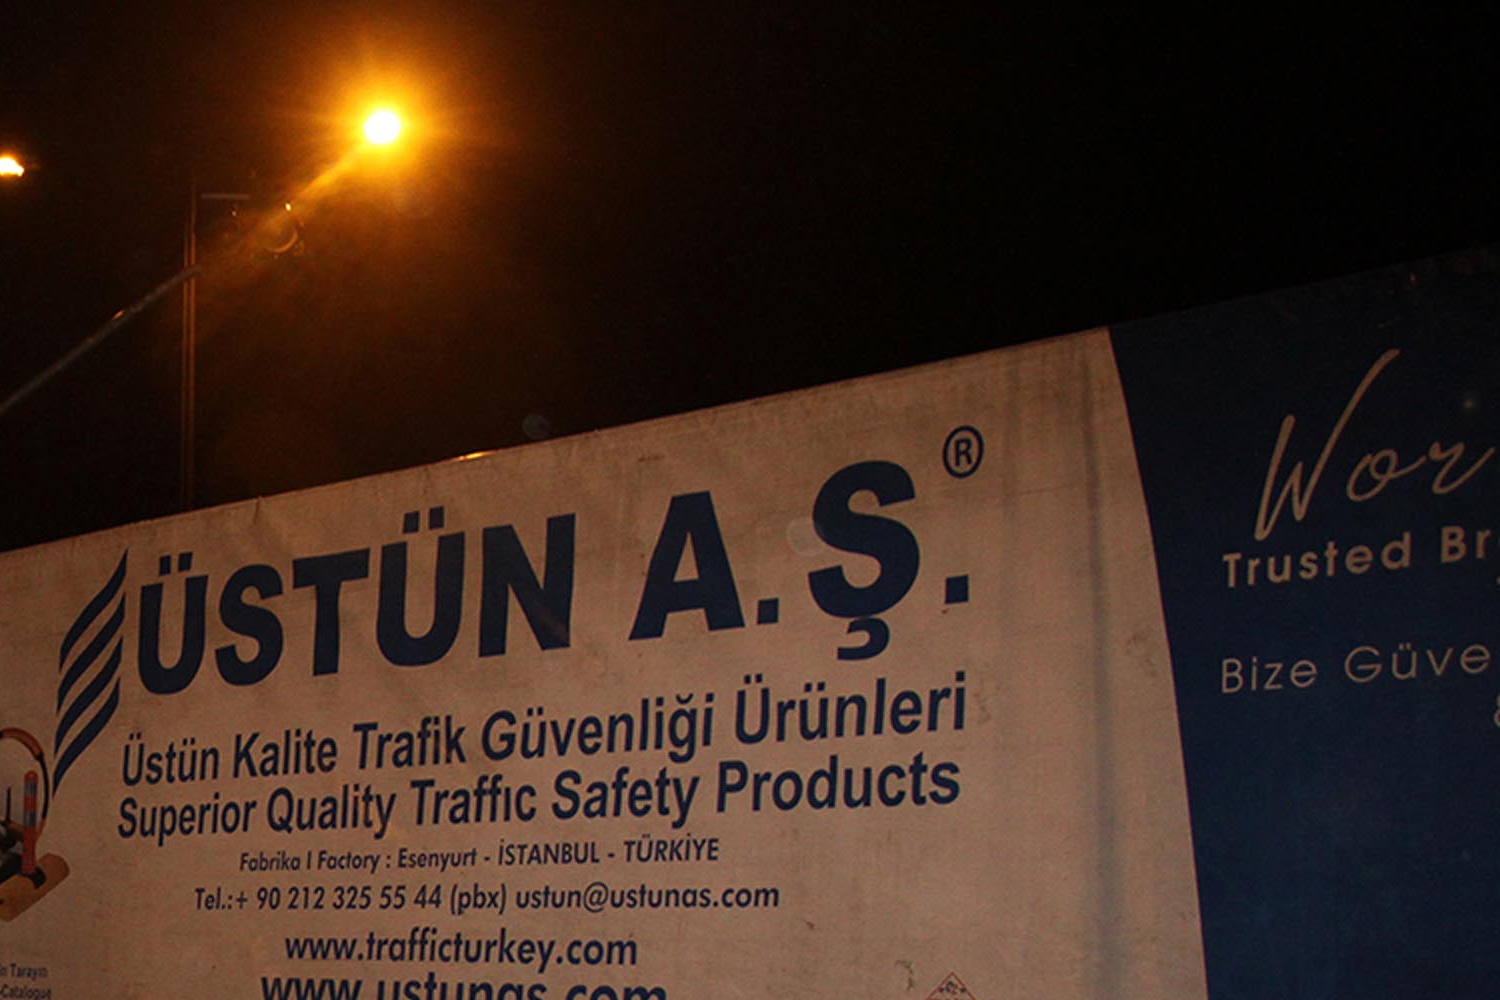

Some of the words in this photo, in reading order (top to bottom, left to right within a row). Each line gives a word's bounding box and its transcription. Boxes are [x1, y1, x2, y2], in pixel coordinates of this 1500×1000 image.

[137, 506, 576, 694] ÜSTÜN
[628, 460, 969, 660] A.Ş.
[1222, 531, 1411, 588] Trusted
[1441, 526, 1500, 563] Br
[1222, 655, 1317, 693] Bize
[1344, 643, 1491, 683] Güve
[122, 733, 220, 786] Üstün
[233, 729, 338, 778] Kalite
[353, 714, 467, 770] Trafik
[481, 692, 714, 764] Güvenliği
[735, 670, 966, 744] Ürünleri
[117, 792, 256, 846] Superior
[266, 784, 397, 840] Quality
[411, 774, 537, 826] Traffic
[552, 766, 700, 829] Safety
[716, 751, 961, 813] Products
[239, 851, 301, 872] Fabrika
[317, 850, 381, 874] Factory
[397, 848, 477, 873] Esenyurt
[498, 839, 600, 866] İSTANBUL
[624, 833, 720, 862] TÜRKİYE
[257, 886, 281, 910] 90
[287, 886, 325, 910] 212
[332, 885, 372, 910] 325
[379, 884, 406, 910] 55
[413, 884, 442, 909] 44
[450, 883, 506, 916] (pbx)
[515, 881, 780, 914] ustun@ustunas.com
[285, 927, 638, 973] www.trafficturkey.com
